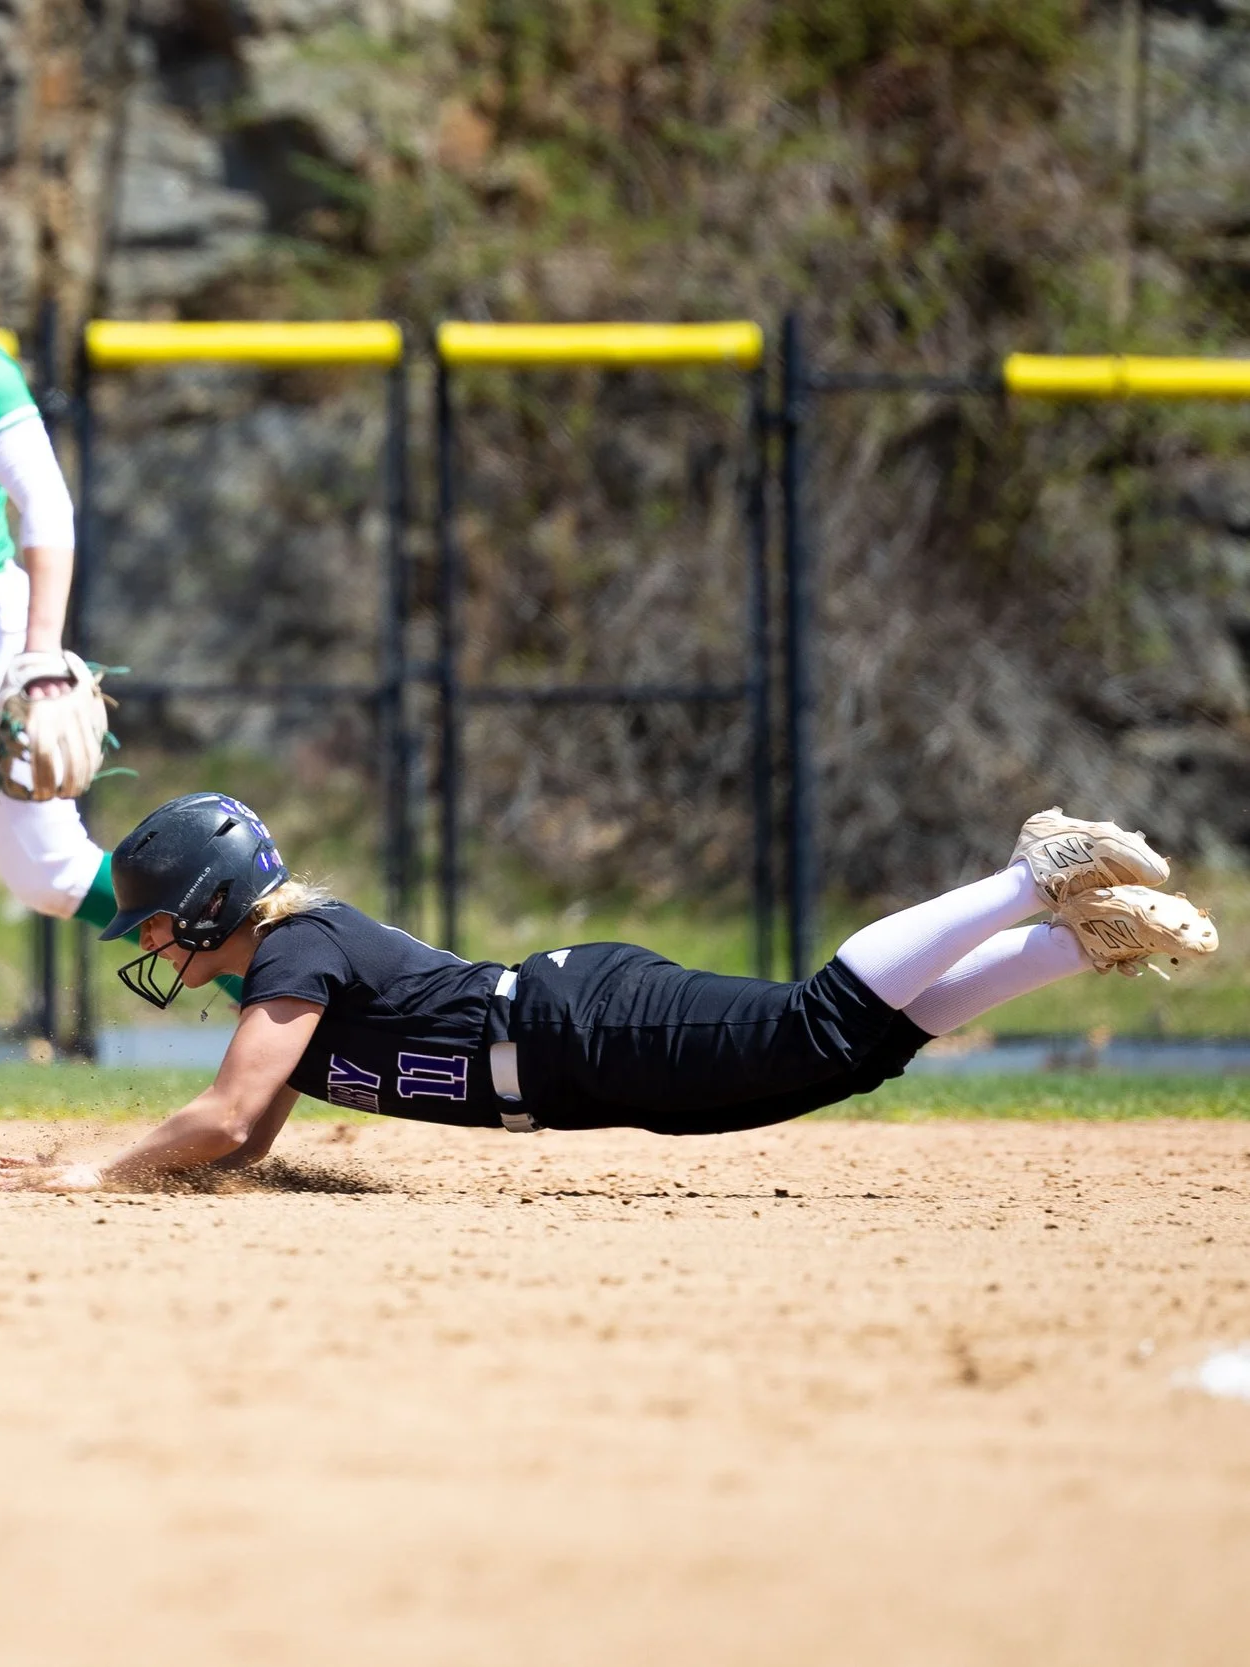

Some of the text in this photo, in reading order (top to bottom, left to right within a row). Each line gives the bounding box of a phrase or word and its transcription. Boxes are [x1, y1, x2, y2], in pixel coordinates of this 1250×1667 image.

[1044, 836, 1094, 869] N
[178, 866, 211, 910] EVOSHIELD
[1089, 919, 1145, 949] N
[396, 1051, 469, 1101] 11
